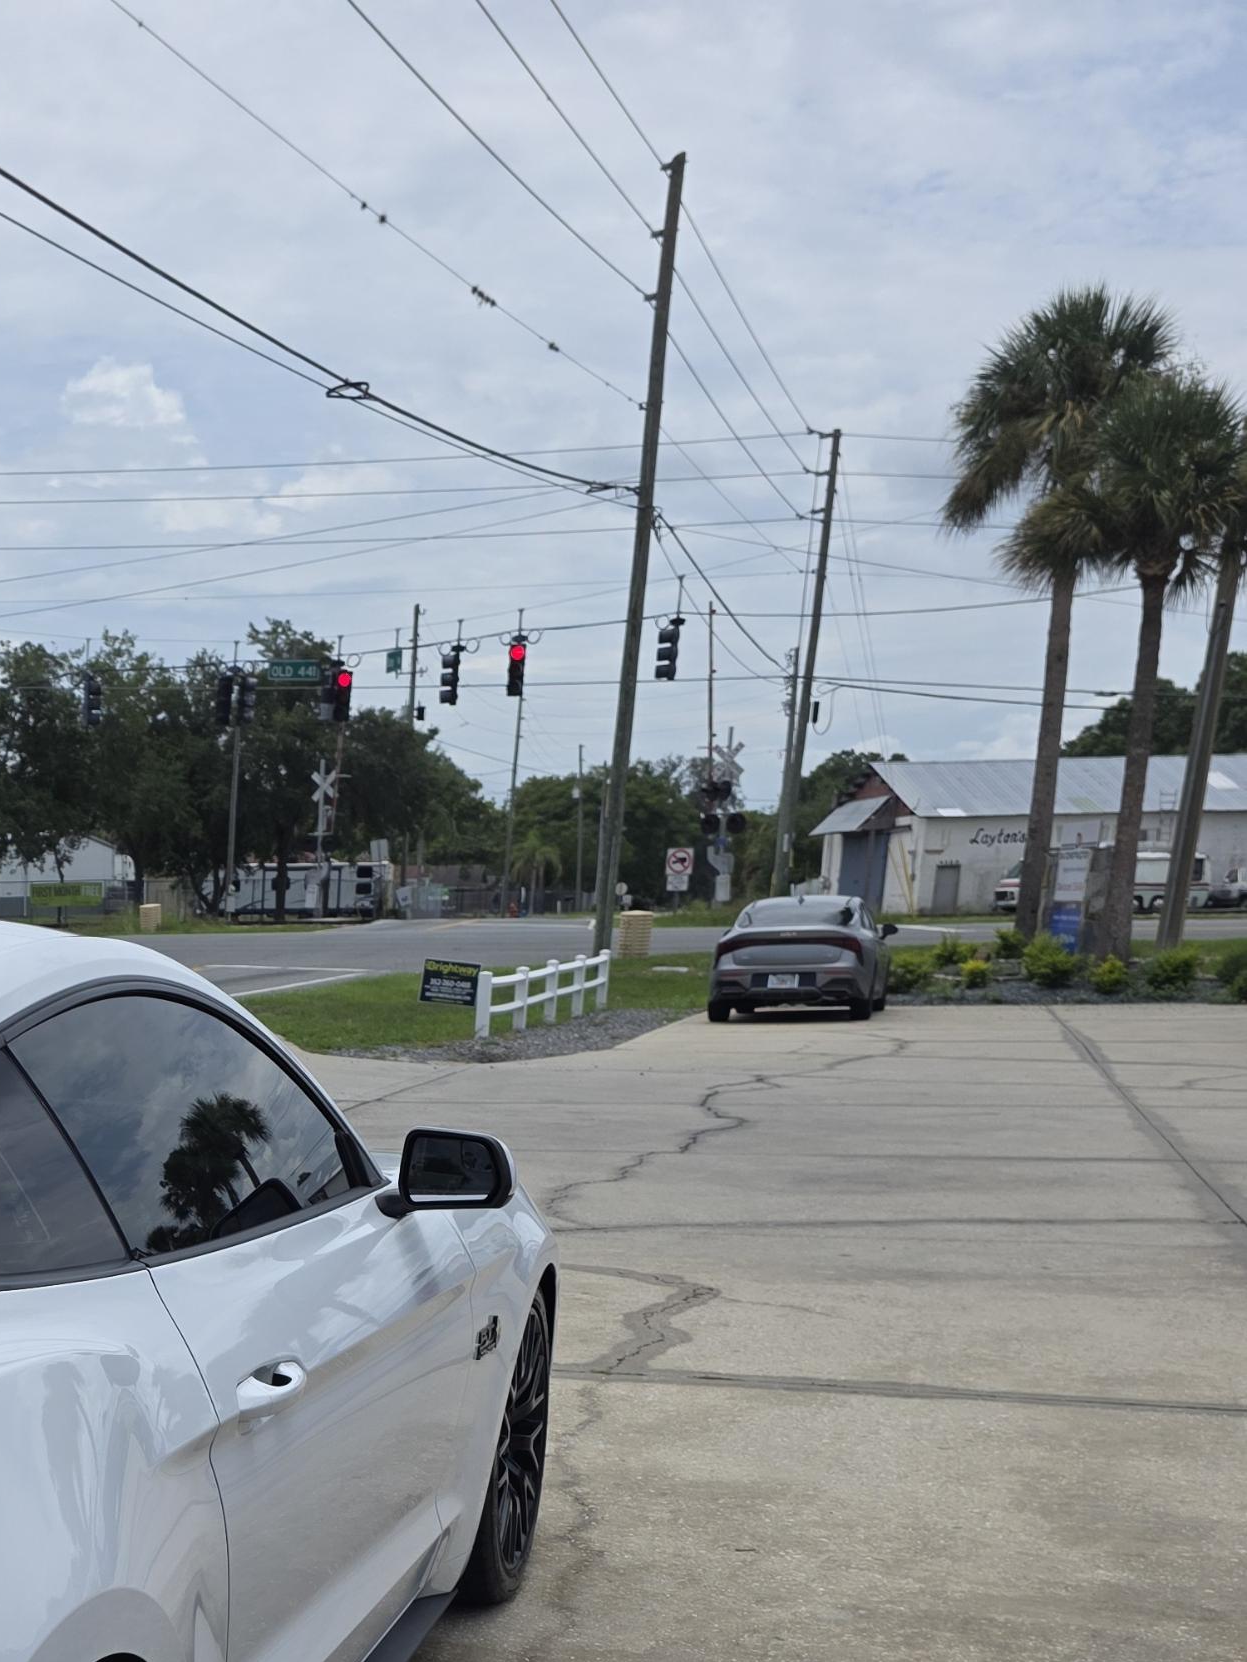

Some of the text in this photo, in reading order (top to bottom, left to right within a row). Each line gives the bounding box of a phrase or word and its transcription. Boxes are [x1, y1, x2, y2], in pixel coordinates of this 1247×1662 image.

[272, 665, 317, 677] OLD 441
[969, 827, 1026, 847] Layton's
[427, 961, 478, 976] Brightway
